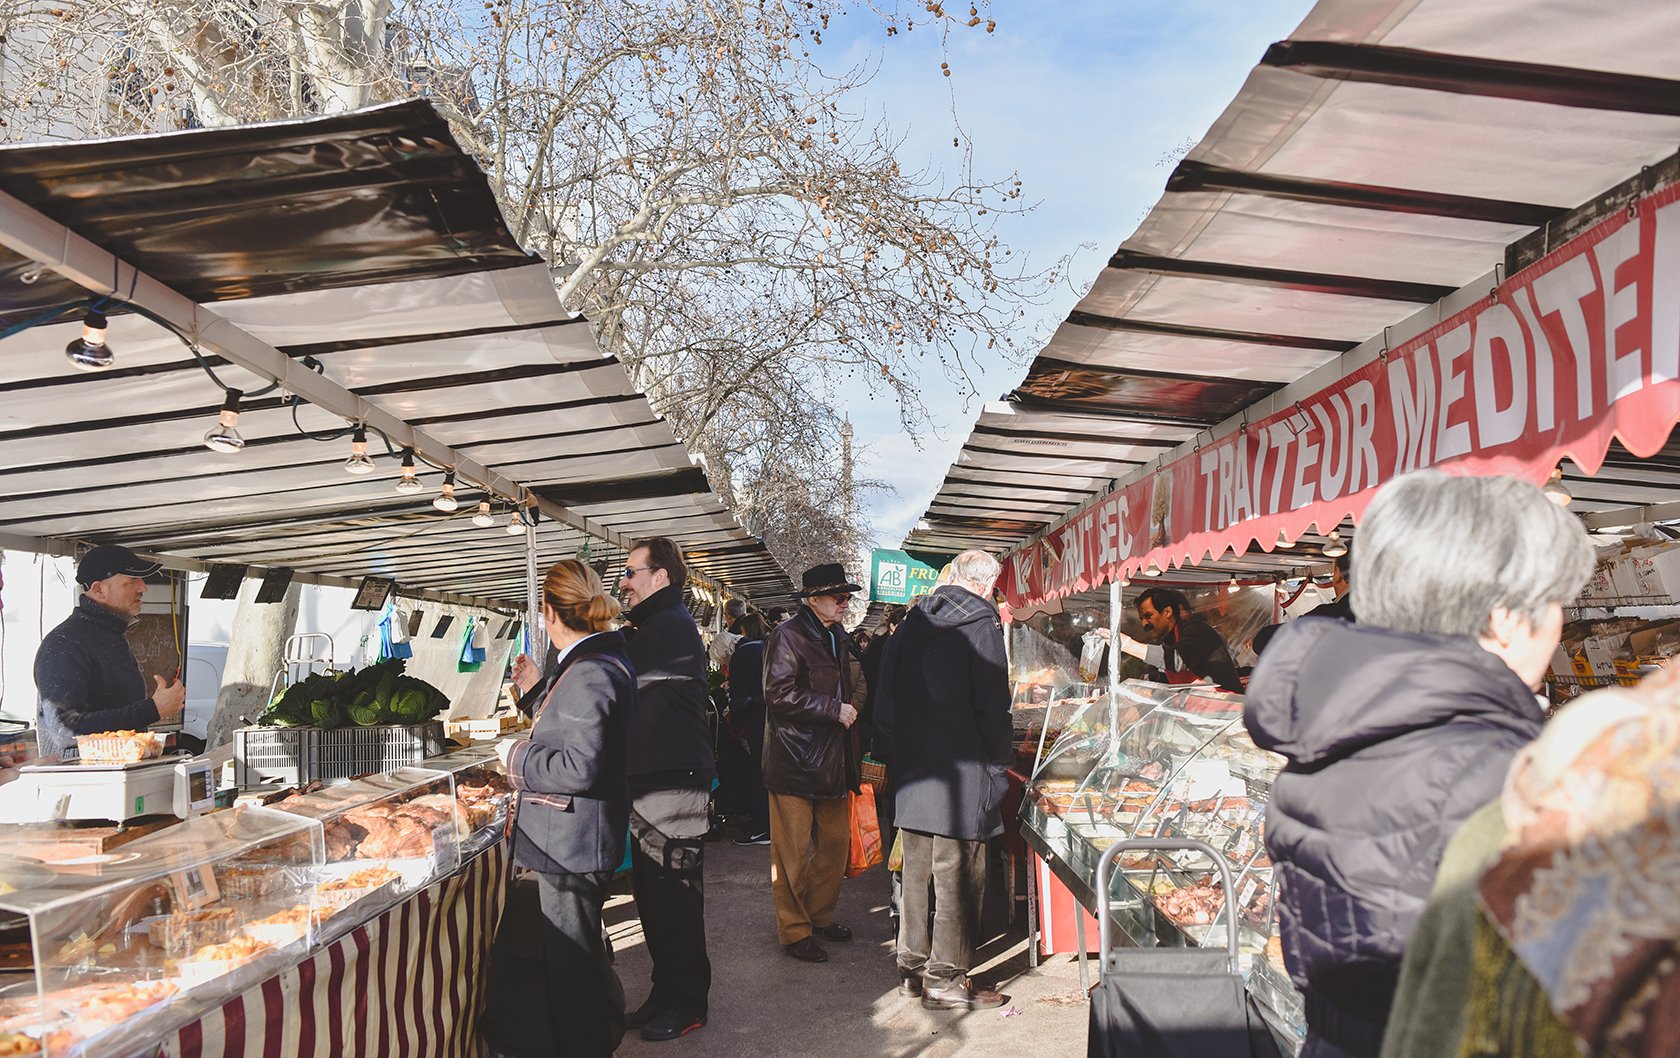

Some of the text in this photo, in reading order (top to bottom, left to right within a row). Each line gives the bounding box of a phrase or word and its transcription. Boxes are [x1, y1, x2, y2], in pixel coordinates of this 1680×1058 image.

[1200, 379, 1379, 532] TRAITEUR
[1099, 495, 1133, 568] SEC
[879, 569, 902, 587] AB
